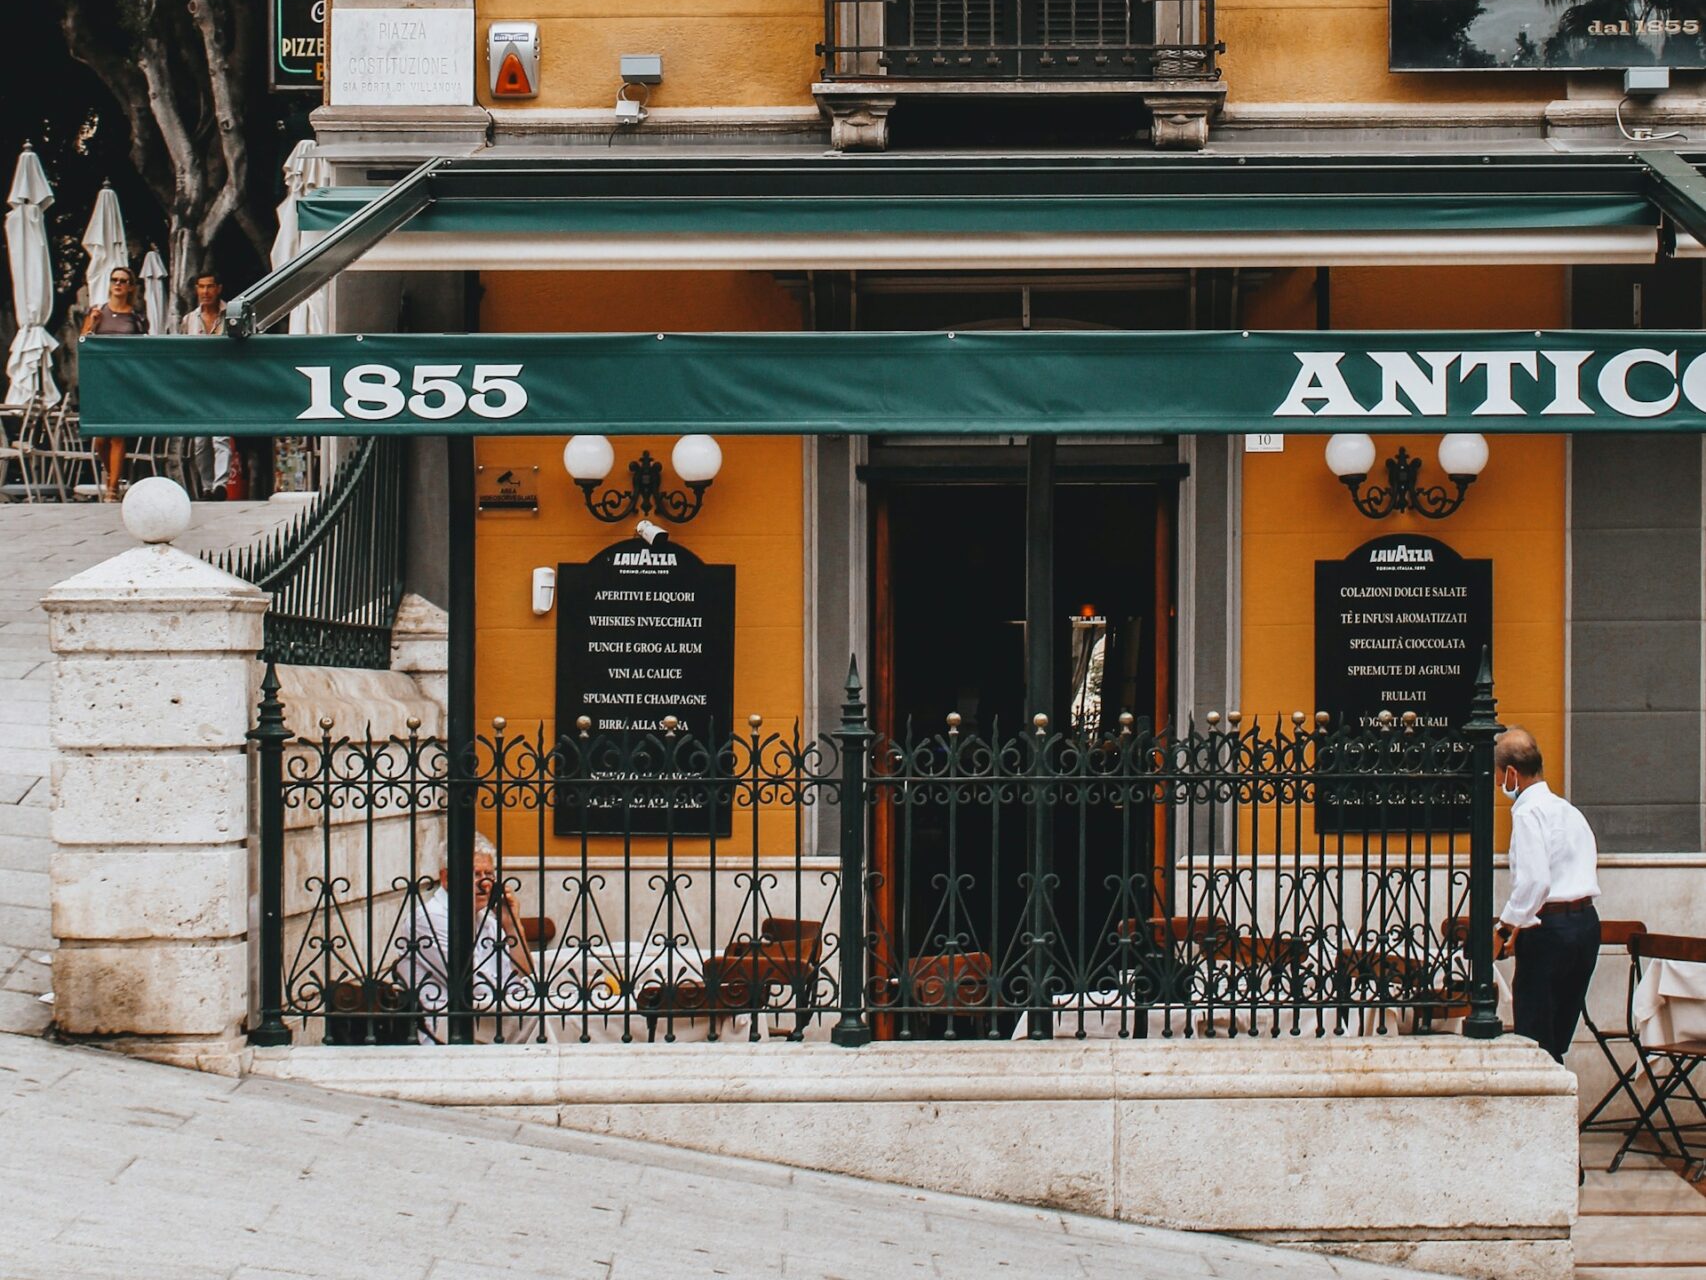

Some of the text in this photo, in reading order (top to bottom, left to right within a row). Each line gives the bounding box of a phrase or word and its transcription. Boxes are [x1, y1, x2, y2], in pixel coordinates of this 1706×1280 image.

[379, 22, 426, 40] PIAZZA
[1587, 20, 1700, 36] dal 1855
[348, 57, 449, 75] COSTITUZIONE
[1273, 348, 1706, 417] ANTIC
[295, 364, 528, 420] 1855
[1258, 434, 1272, 446] 10
[613, 549, 677, 566] LAVAZZA
[1369, 545, 1435, 562] LAVAZZA
[595, 591, 695, 603] APERITIVI E LIQUORI
[1340, 586, 1467, 597] COLAZIONI DOLCI E SALATE
[589, 616, 702, 627] WHISKIES INVECCHIATI
[1354, 613, 1361, 623] E
[1362, 613, 1394, 623] INFUSI
[1395, 612, 1467, 623] AROMATIZZATI
[588, 642, 702, 653] PUNCH E GROG AL RUM
[1349, 636, 1466, 649] SPECIALITÀ CIOCCOLATA
[608, 668, 682, 679] VINI AL CALICE
[1347, 665, 1461, 675] SPREMUTE DI AGRUMI
[583, 693, 707, 705] SPUMANTI E CHAMPAGNE
[1381, 691, 1426, 701] FRULLATI
[631, 720, 657, 730] ALLA
[659, 720, 689, 731] SNA
[1400, 717, 1448, 727] TURALI
